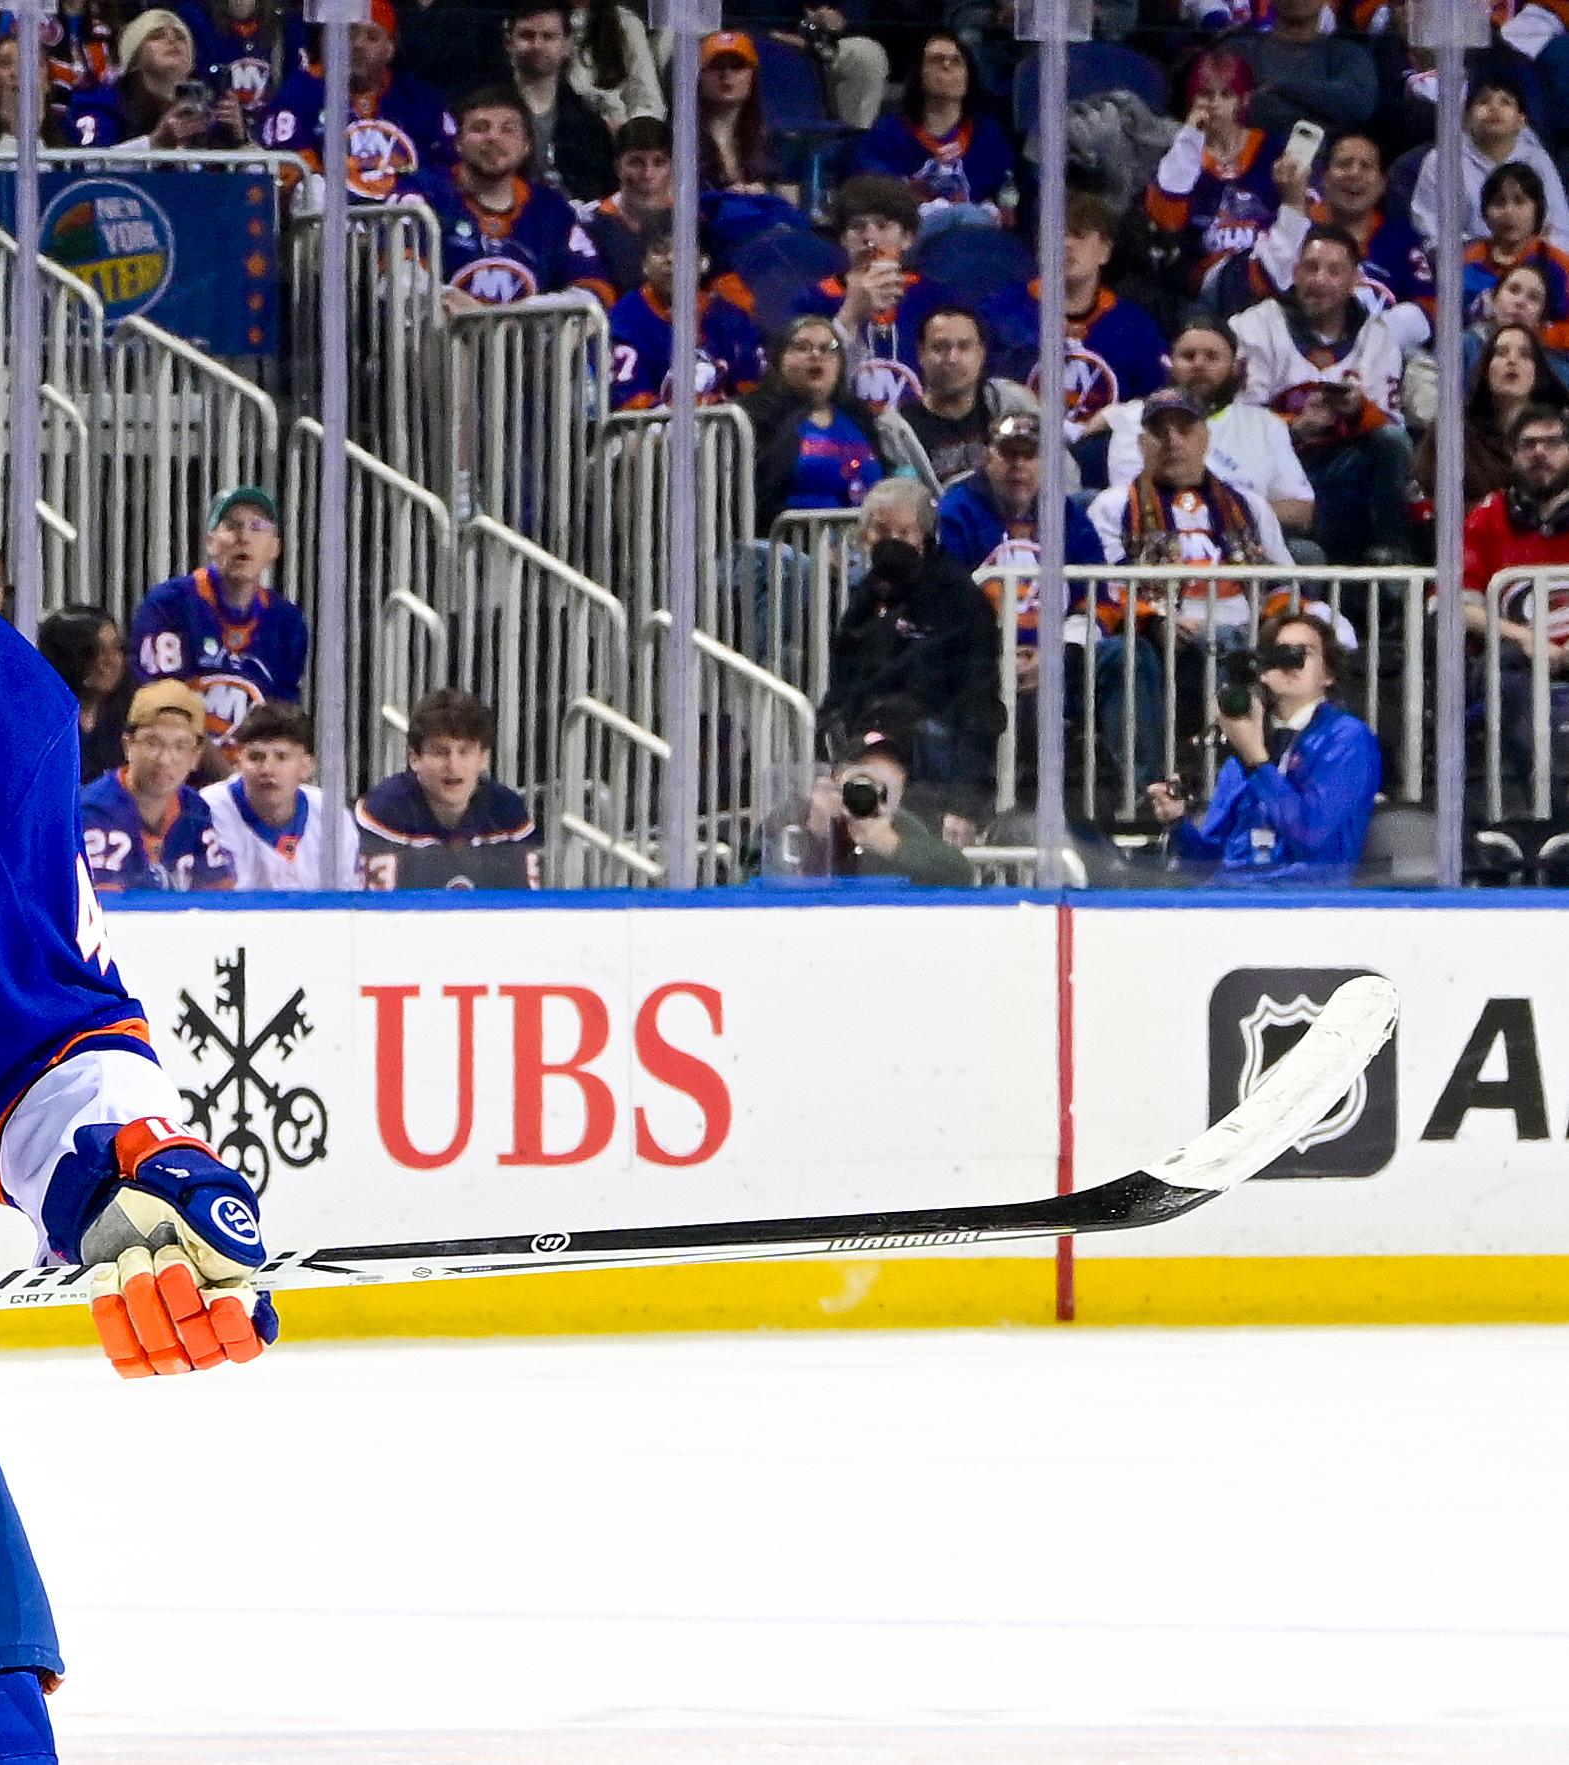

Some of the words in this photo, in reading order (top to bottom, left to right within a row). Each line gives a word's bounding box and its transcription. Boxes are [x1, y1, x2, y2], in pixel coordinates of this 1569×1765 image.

[83, 828, 132, 872] 27
[360, 982, 732, 1170] UBS
[1419, 997, 1569, 1142] A
[830, 1231, 978, 1251] WARRIOR
[9, 1292, 55, 1306] QR7
[60, 1291, 88, 1300] PRO
